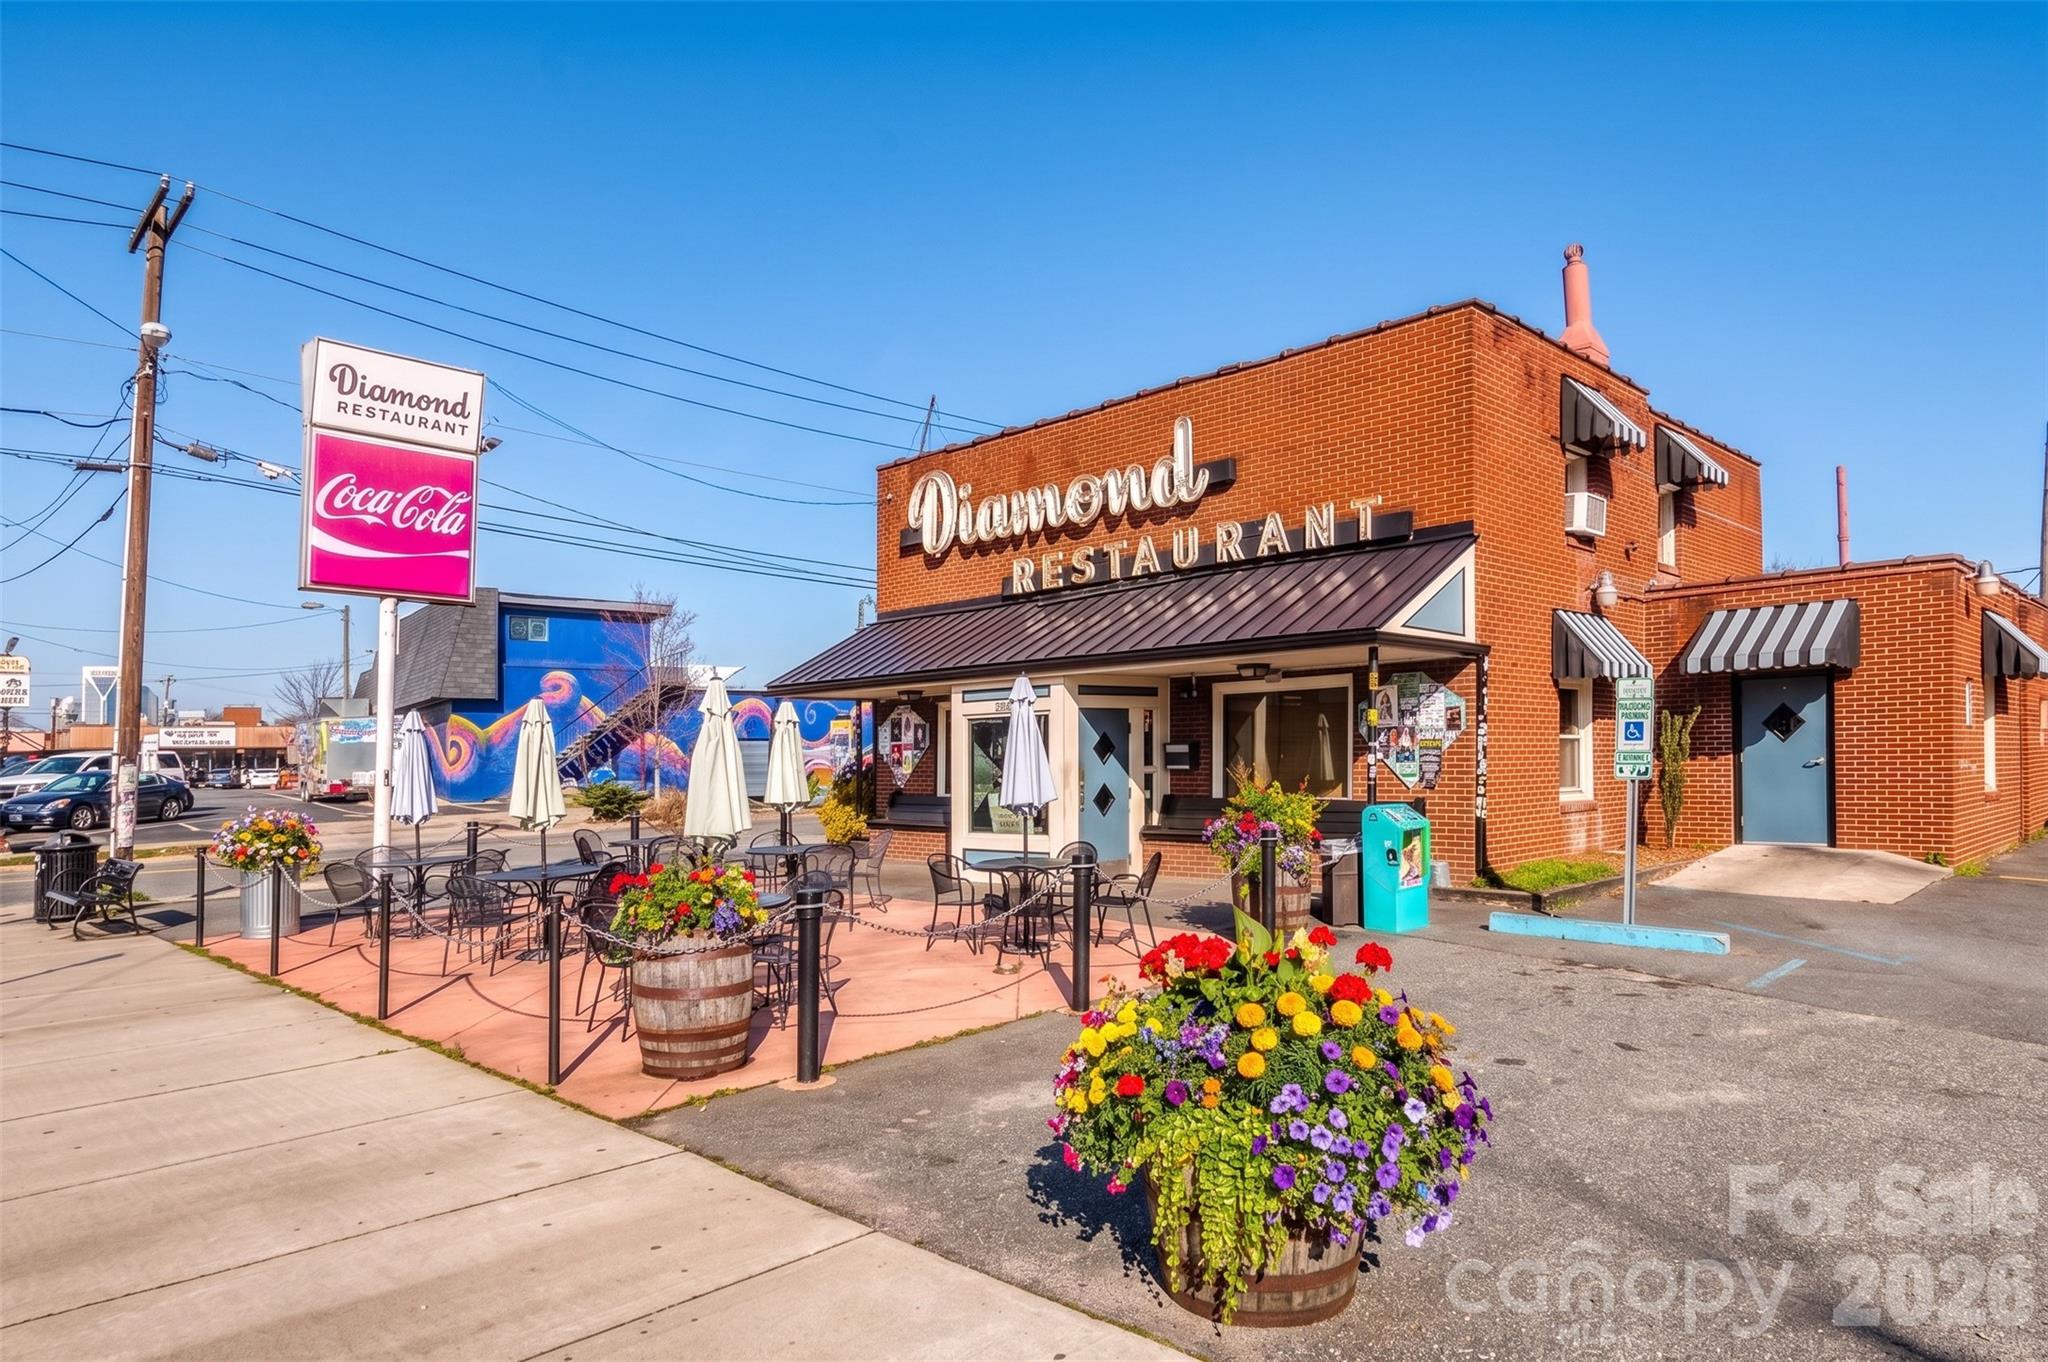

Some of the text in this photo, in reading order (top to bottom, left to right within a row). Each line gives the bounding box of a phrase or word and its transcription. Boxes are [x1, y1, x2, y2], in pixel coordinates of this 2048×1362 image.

[329, 363, 470, 419] Diamond
[337, 401, 468, 436] RESTAURANT
[315, 473, 472, 535] Coca-Cola
[908, 417, 1210, 557] Diamond
[1012, 496, 1383, 594] RESTAURANT
